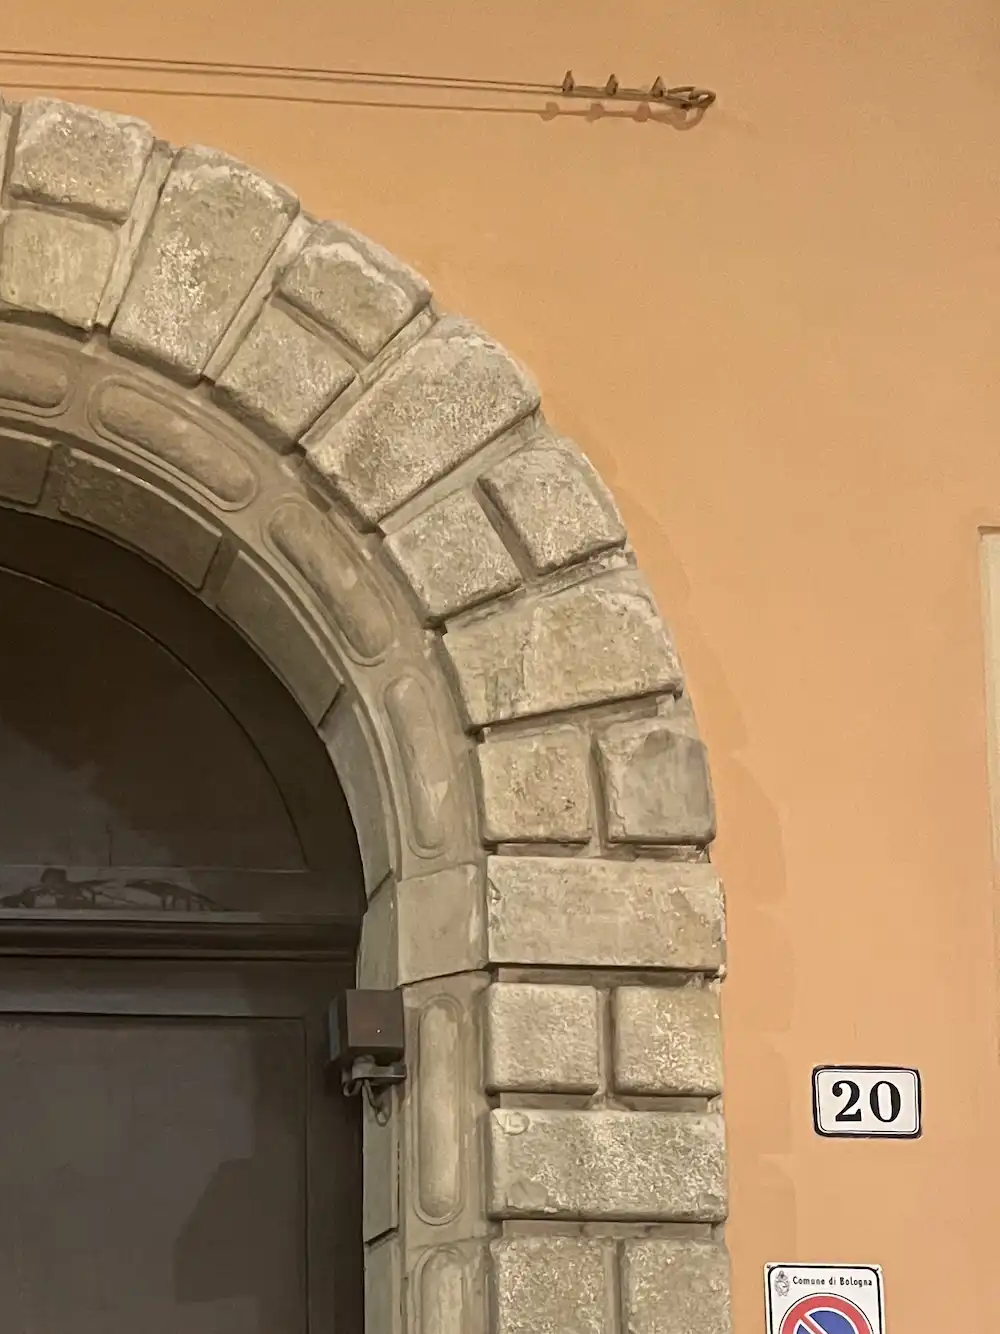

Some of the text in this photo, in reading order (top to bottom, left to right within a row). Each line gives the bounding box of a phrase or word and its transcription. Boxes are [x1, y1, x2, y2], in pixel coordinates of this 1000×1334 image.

[831, 1080, 902, 1123] 20
[792, 1275, 873, 1288] Comune di Bologna
